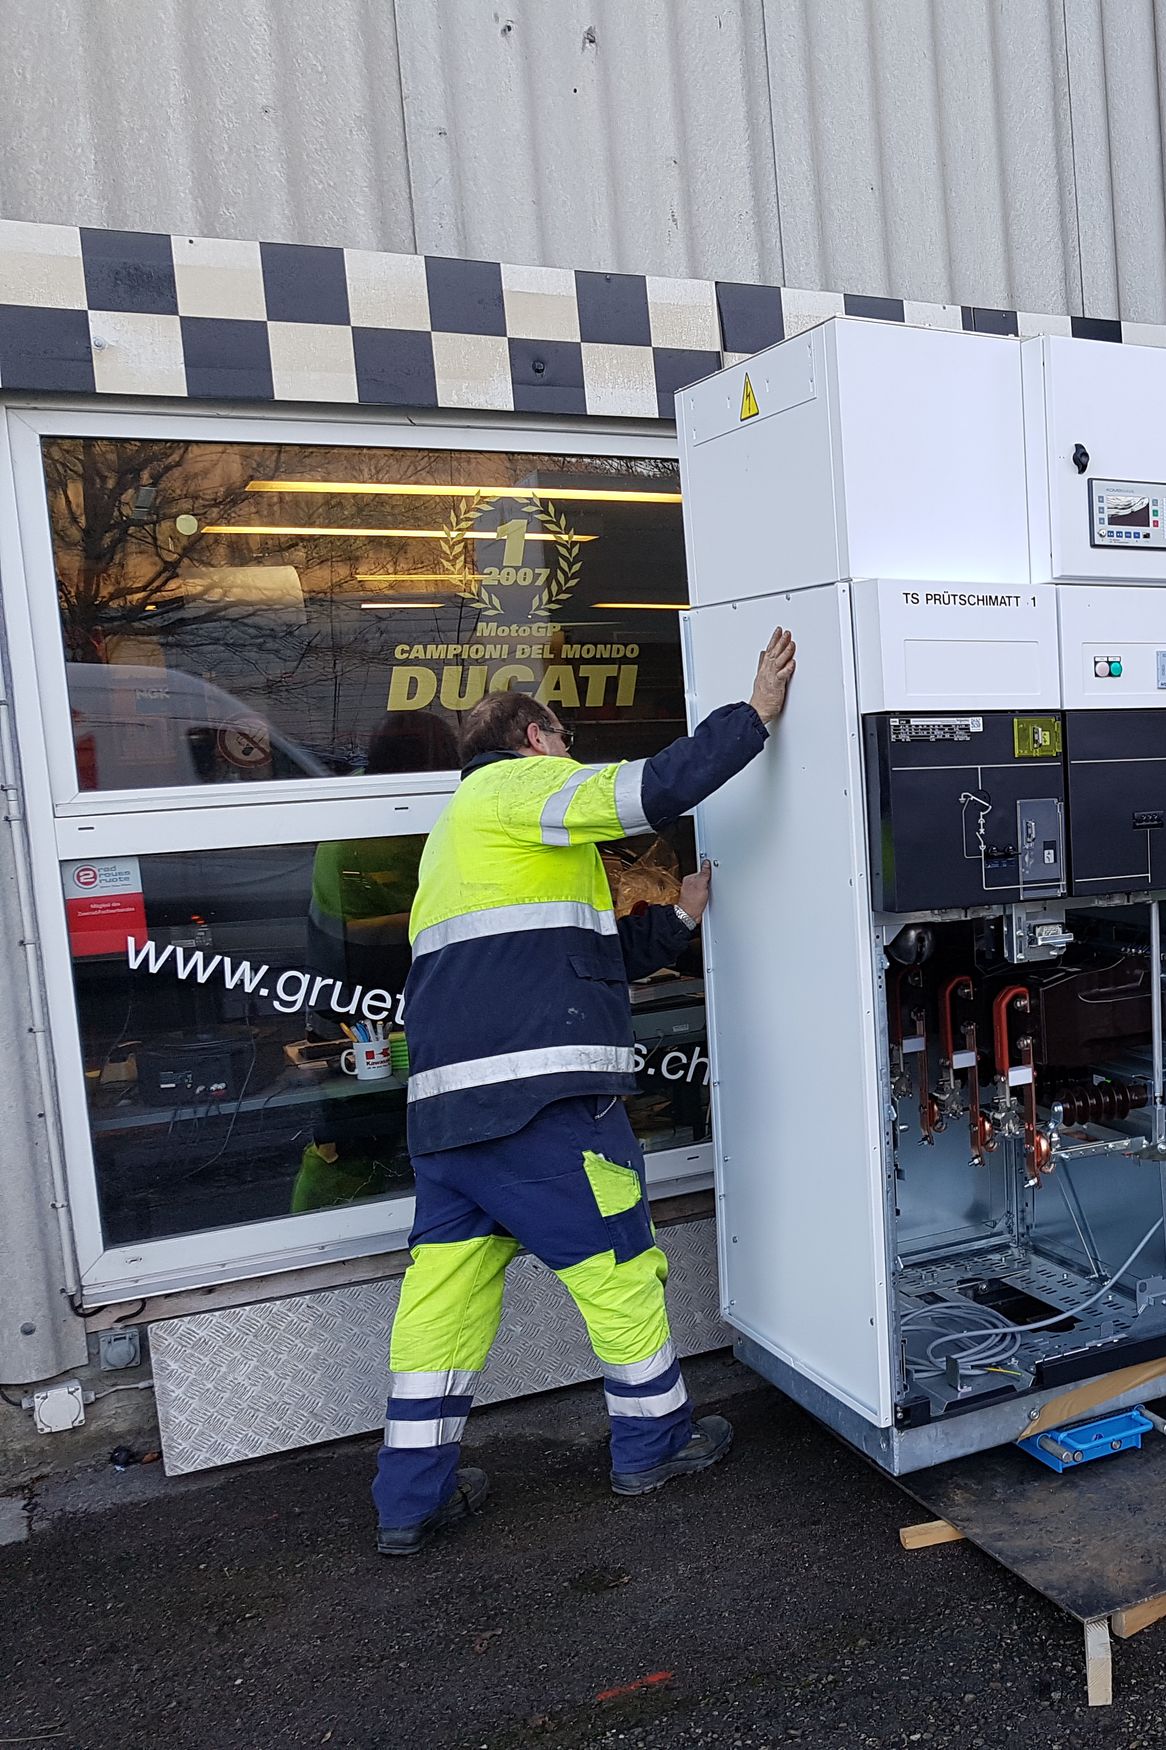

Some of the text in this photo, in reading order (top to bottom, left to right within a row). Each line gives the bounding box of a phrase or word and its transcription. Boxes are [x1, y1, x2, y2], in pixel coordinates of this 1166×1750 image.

[496, 519, 528, 567] 1
[482, 567, 551, 586] 2007
[902, 591, 1037, 608] TS PRÜTSCHIMATT 1
[476, 622, 562, 637] MotoGP
[394, 643, 640, 660] CAMPIONI DEL MONDO
[387, 664, 639, 712] DUCATI
